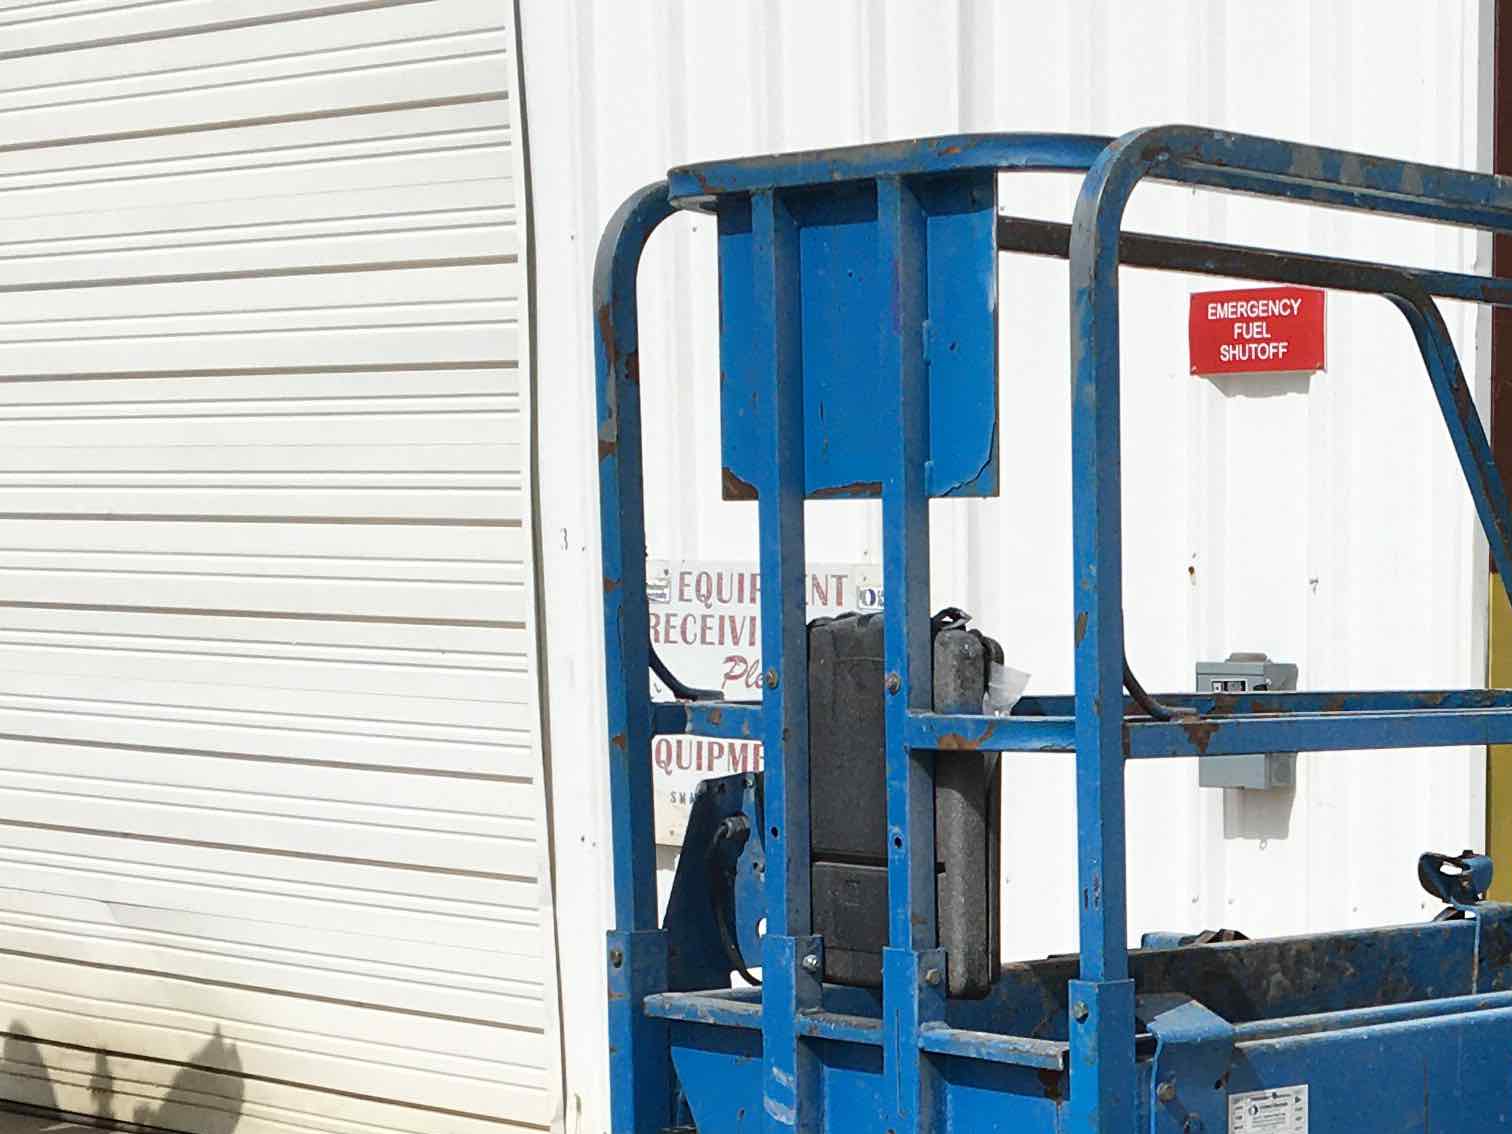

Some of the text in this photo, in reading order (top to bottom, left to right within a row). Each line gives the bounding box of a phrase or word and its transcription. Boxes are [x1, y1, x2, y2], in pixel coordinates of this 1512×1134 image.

[1207, 298, 1302, 320] EMERGENCY
[1233, 321, 1271, 339] FUEL
[1219, 342, 1289, 362] SHUTOFF
[678, 571, 849, 609] EQUINT
[648, 612, 757, 647] RECEIVI
[654, 738, 764, 777] QUIPM
